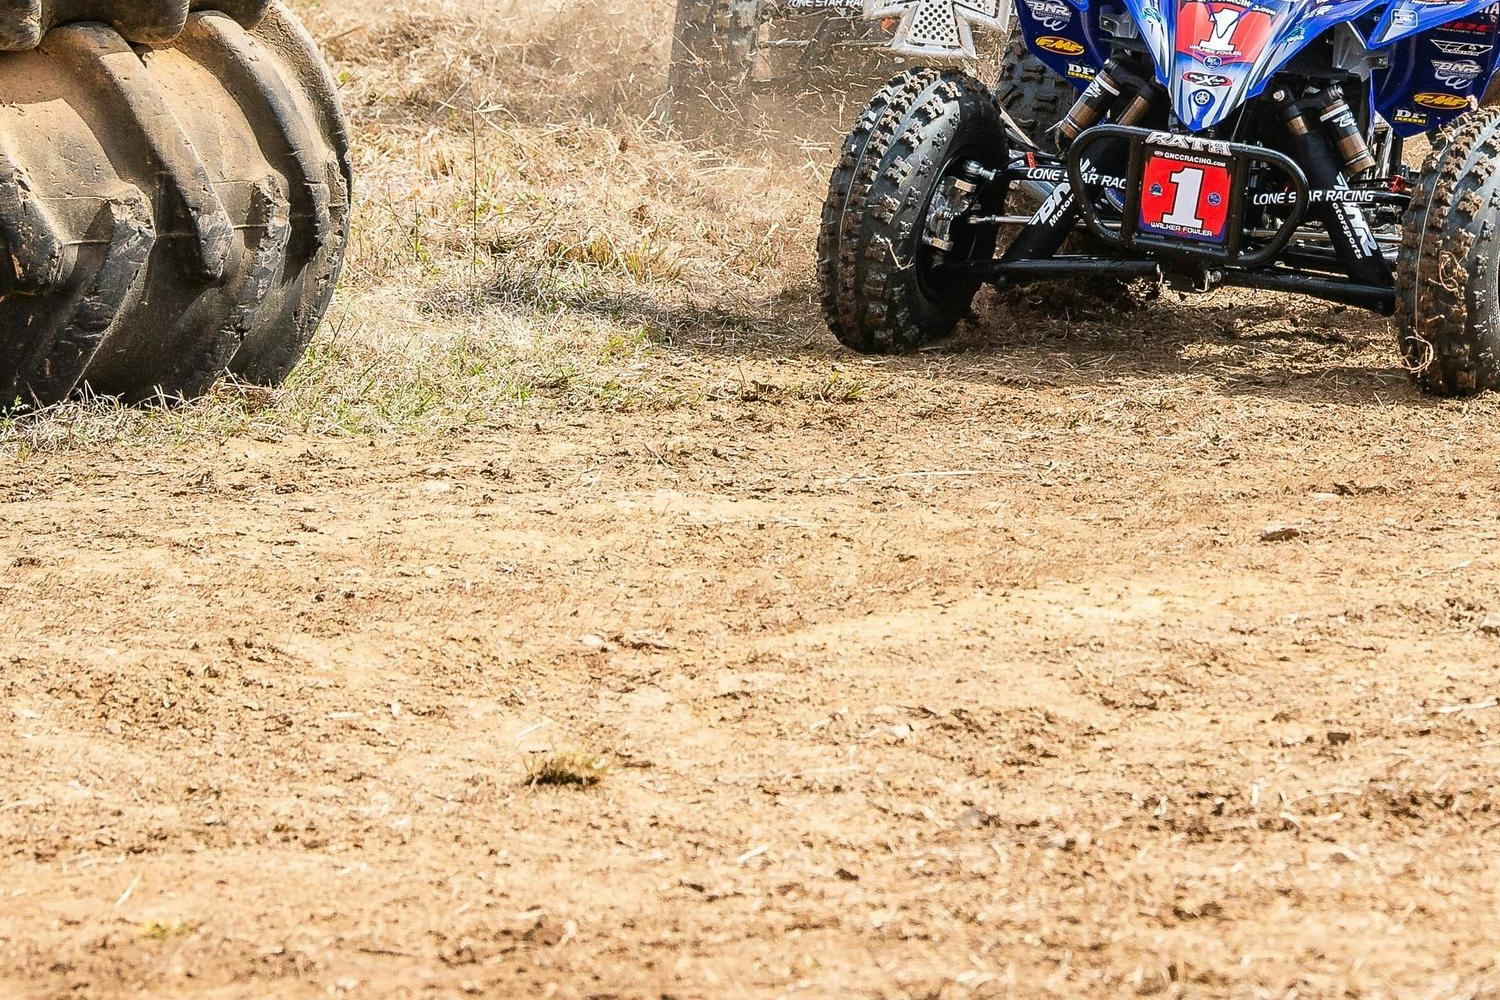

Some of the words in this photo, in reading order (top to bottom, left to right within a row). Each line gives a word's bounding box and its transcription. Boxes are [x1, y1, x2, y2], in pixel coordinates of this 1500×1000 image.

[1033, 1, 1070, 16] BNR
[1198, 7, 1240, 52] 1
[1036, 37, 1084, 54] FMF
[1068, 63, 1096, 75] DP
[1438, 61, 1482, 73] BNR
[1416, 94, 1469, 107] FMF
[1145, 131, 1232, 156] RATH
[1026, 167, 1061, 181] LONE
[1161, 167, 1204, 229] 1
[1253, 192, 1285, 206] LONE
[1325, 189, 1375, 202] RACING
[1150, 221, 1181, 233] WALKER
[1182, 227, 1213, 237] FOWLER
[1331, 201, 1363, 260] otorsports
